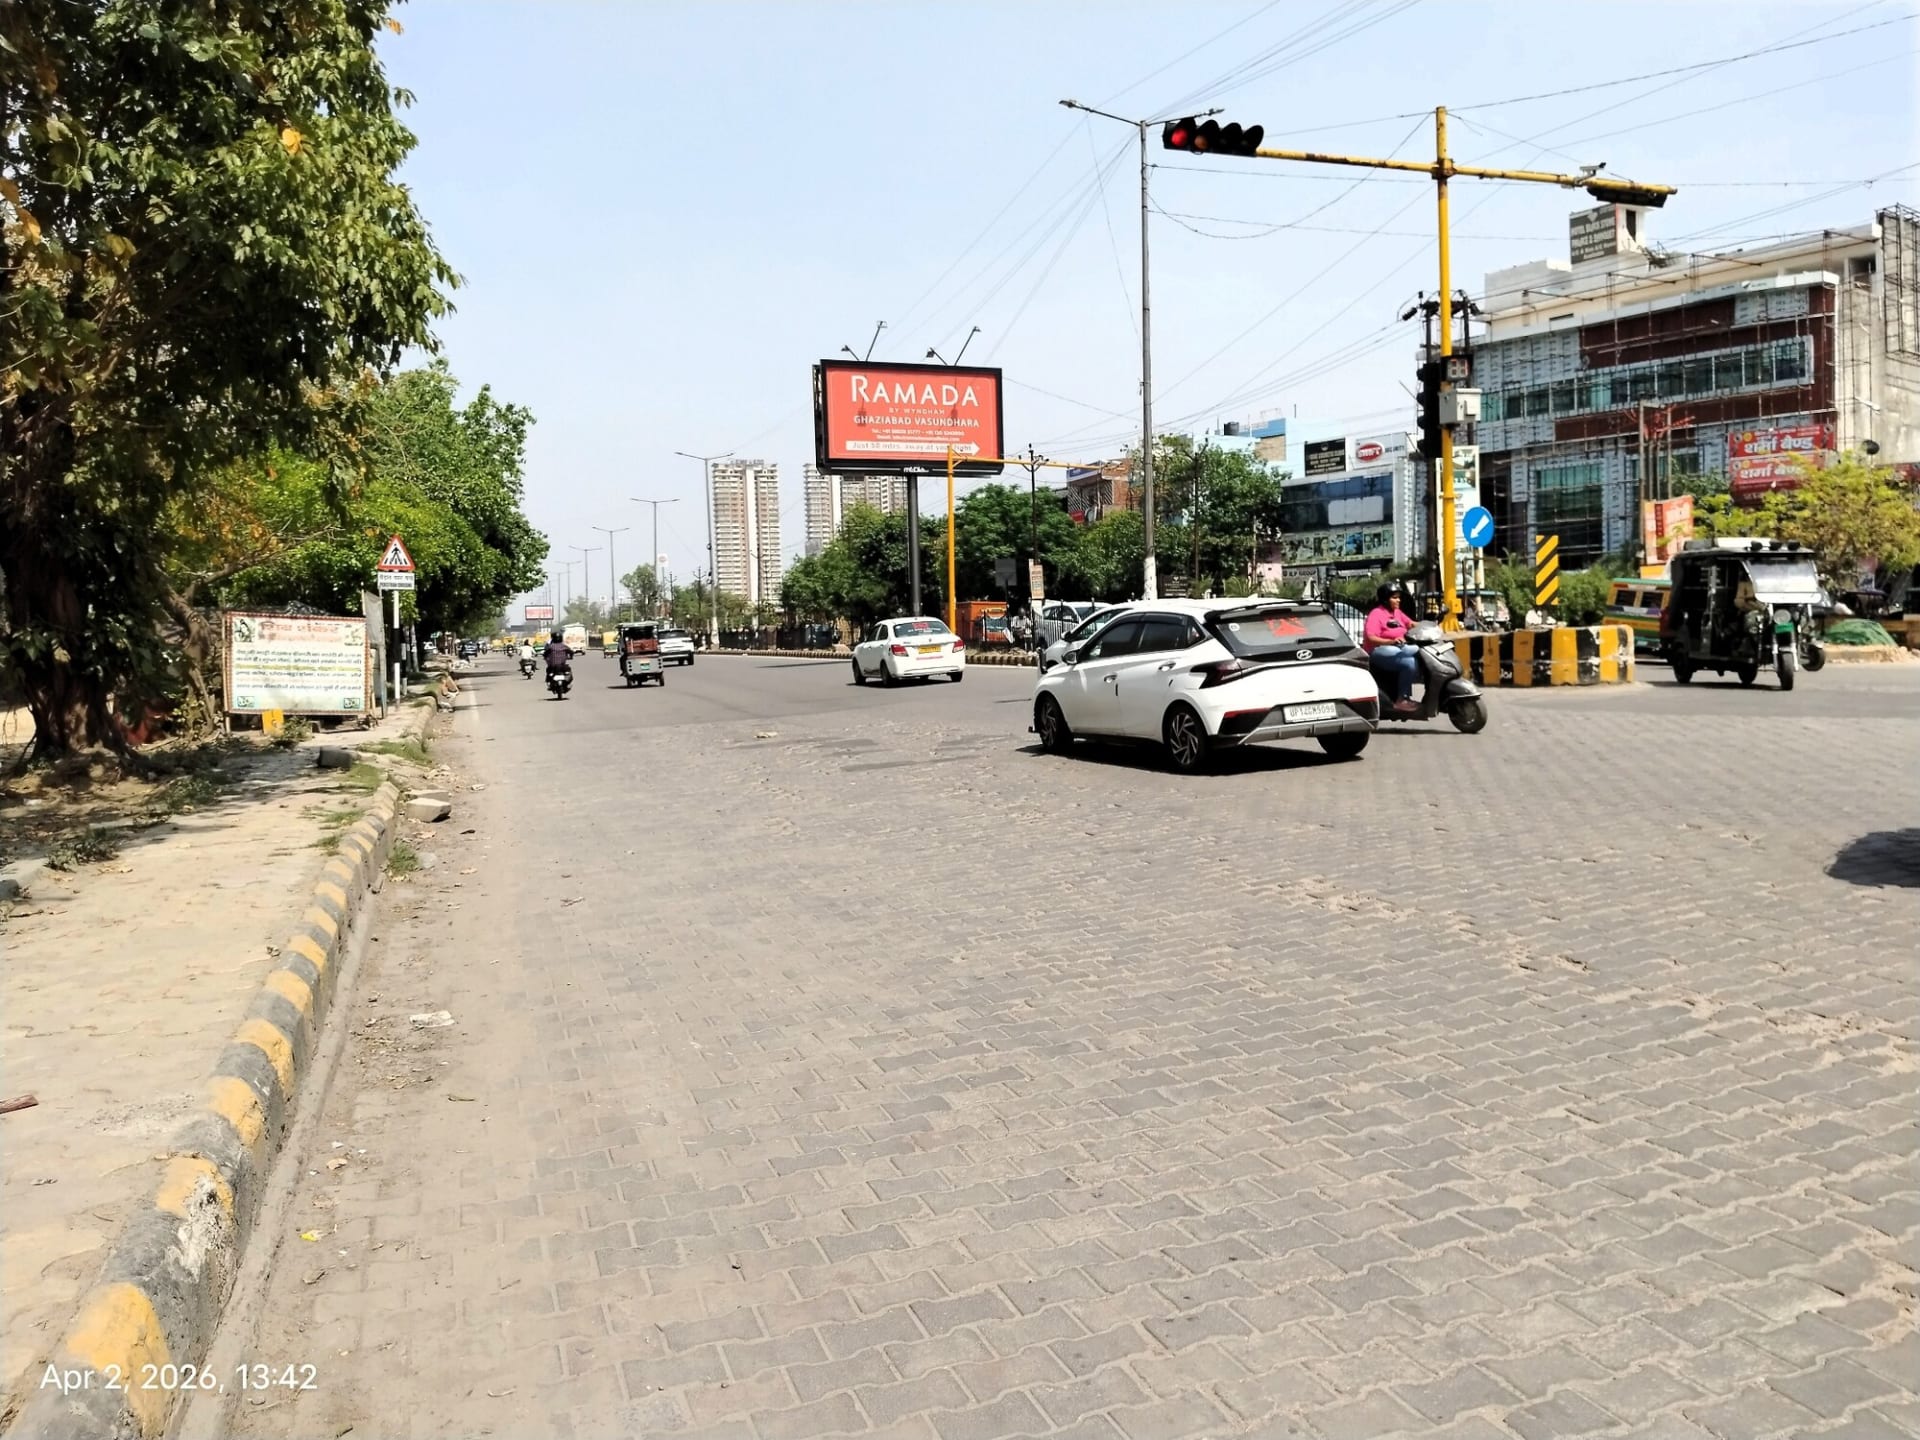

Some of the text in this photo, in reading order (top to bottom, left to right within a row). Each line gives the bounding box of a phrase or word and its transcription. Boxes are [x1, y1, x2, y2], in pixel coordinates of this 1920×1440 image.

[851, 375, 979, 407] RAMADA
[853, 415, 979, 427] GHAZIABAD VASUNDHARA
[905, 444, 923, 452] away
